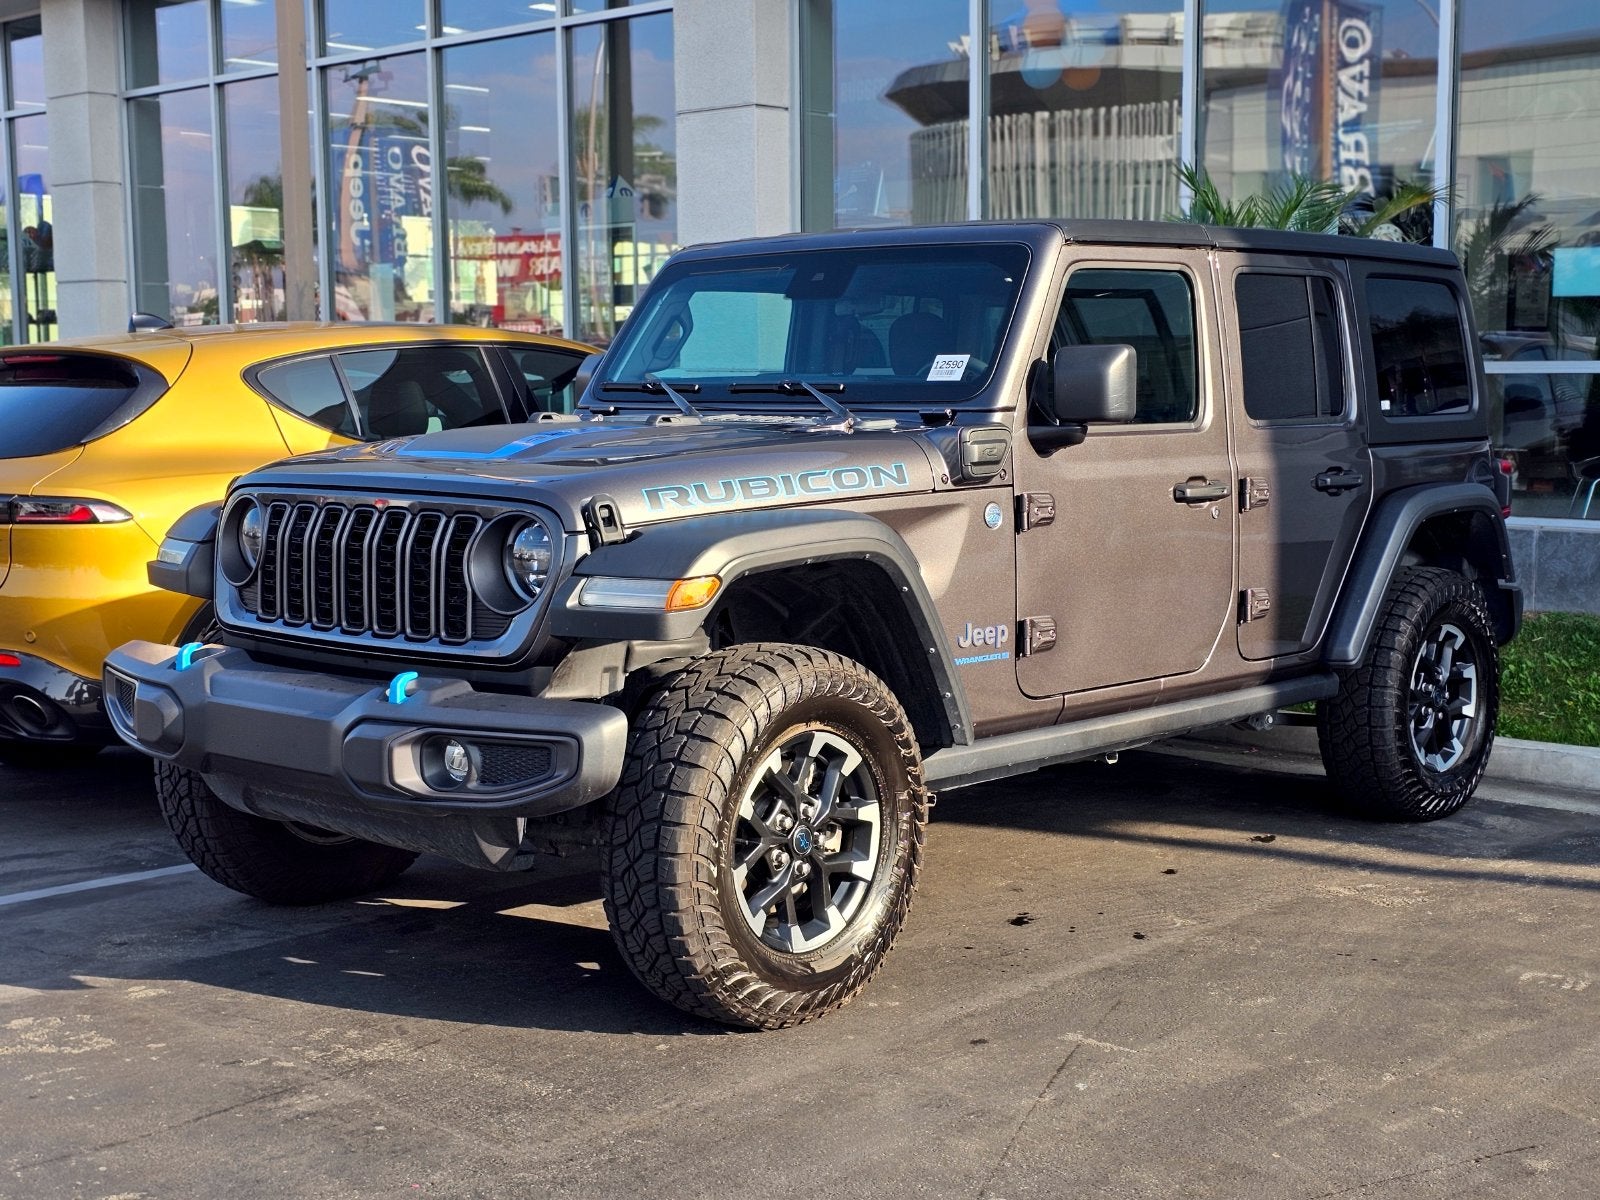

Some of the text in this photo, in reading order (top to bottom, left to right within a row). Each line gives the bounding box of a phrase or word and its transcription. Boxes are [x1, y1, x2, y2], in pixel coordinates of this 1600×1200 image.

[934, 360, 964, 370] 12590
[641, 463, 910, 512] RUBICON
[956, 622, 1009, 649] Jeep
[954, 653, 1001, 666] WRANGLER
